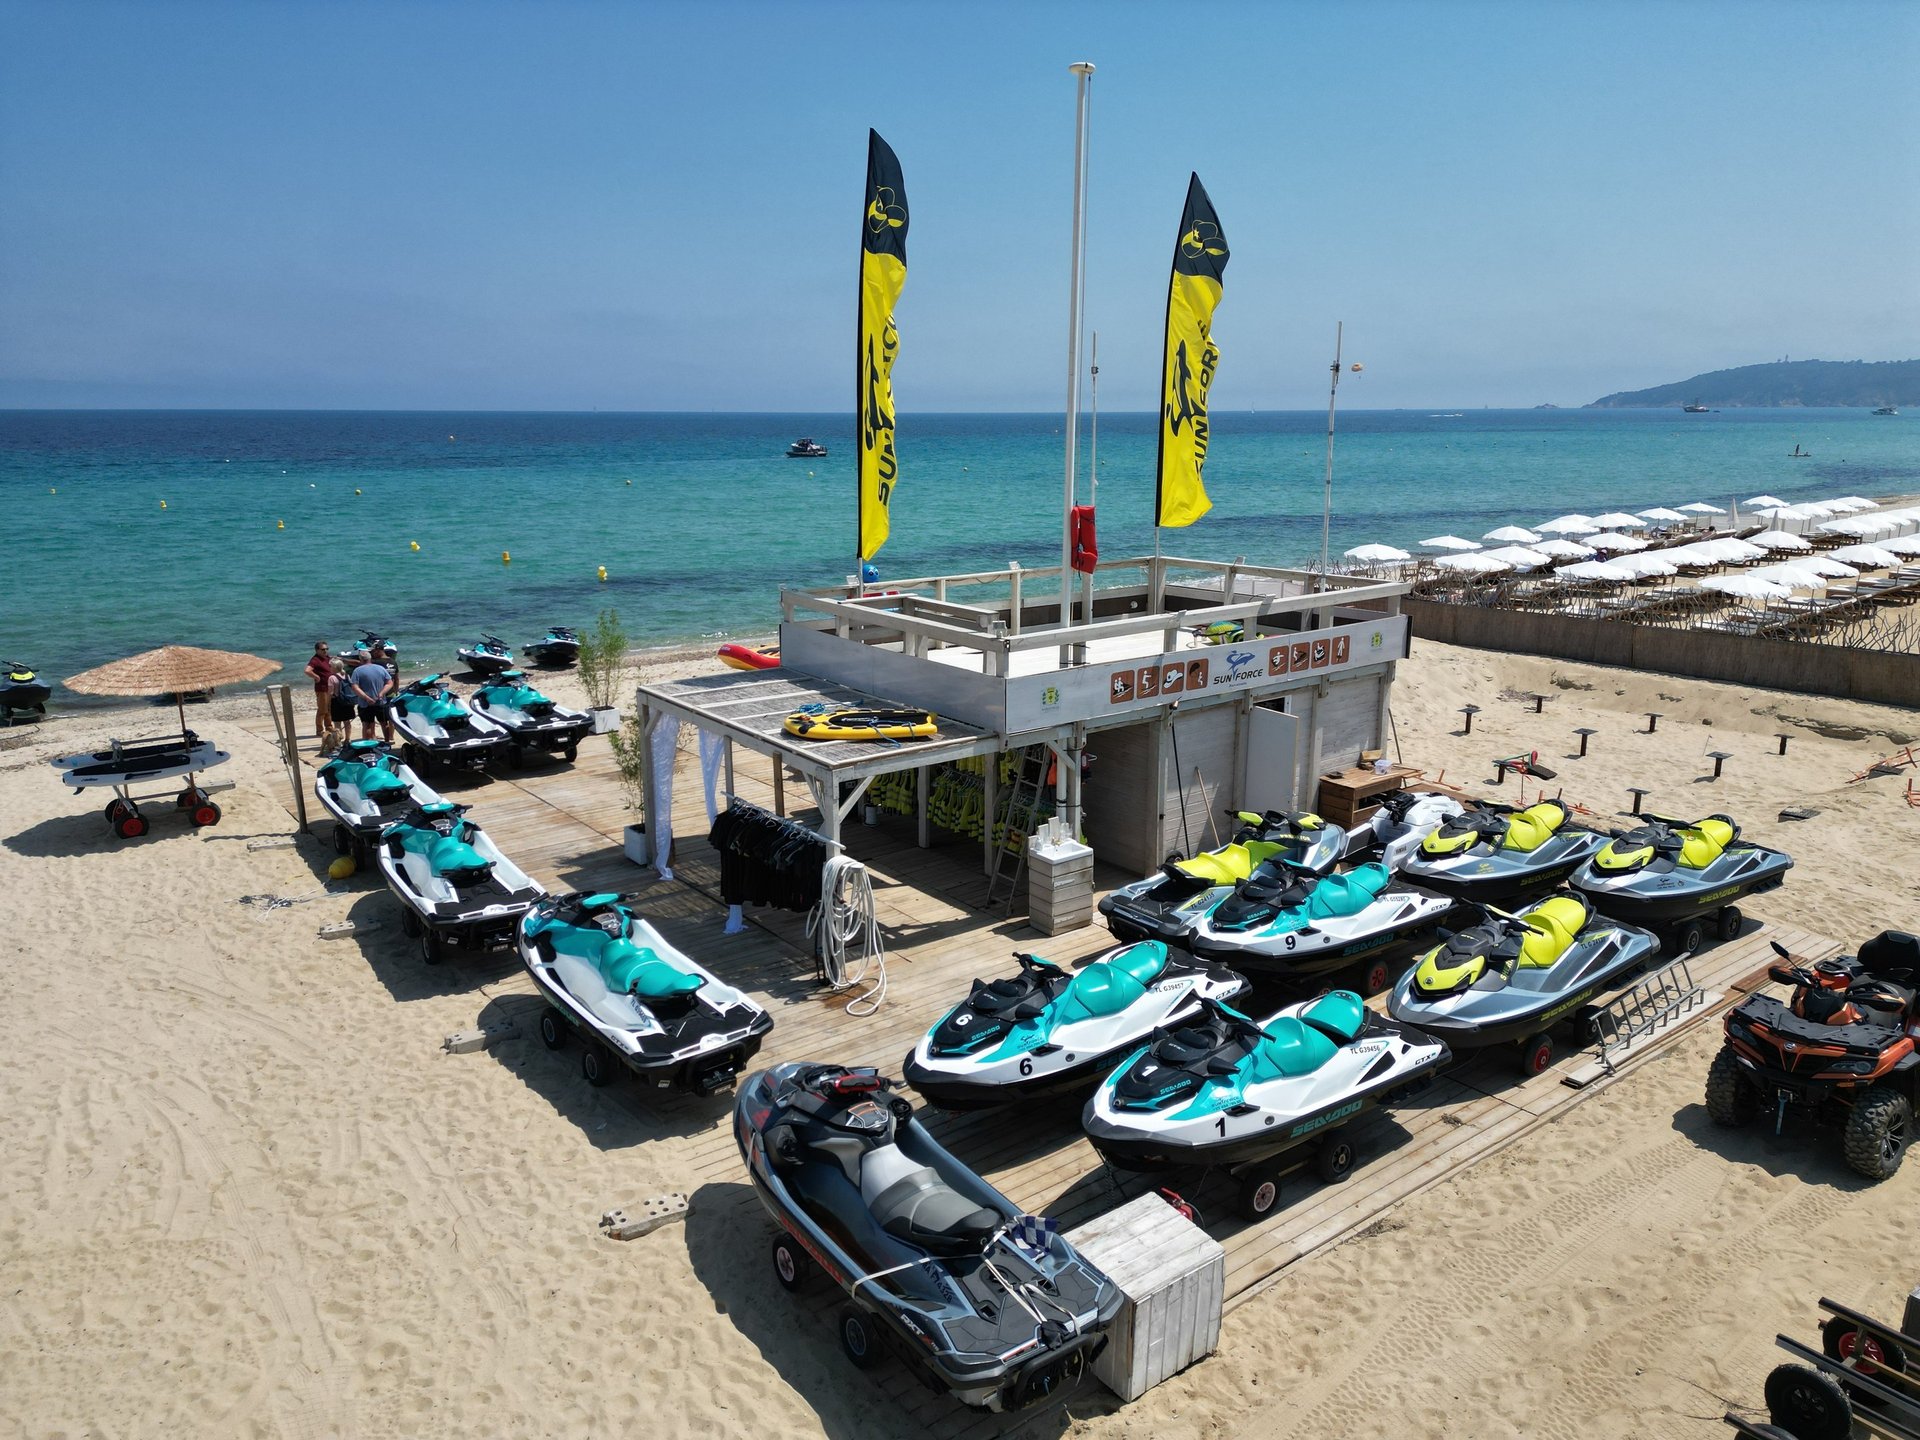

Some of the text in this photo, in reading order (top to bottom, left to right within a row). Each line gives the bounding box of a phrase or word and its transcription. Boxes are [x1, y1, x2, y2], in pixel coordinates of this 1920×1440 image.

[1213, 674, 1232, 685] SUN
[1235, 668, 1263, 681] FORCE
[1285, 934, 1297, 951] 9
[1154, 982, 1185, 994] TL G39457
[1215, 987, 1231, 1000] GTX
[955, 1013, 974, 1026] 6
[1350, 1044, 1381, 1055] TL G39456
[1019, 1057, 1033, 1076] 6
[1414, 1054, 1432, 1066] GTX
[1141, 1065, 1159, 1077] 1
[1215, 1117, 1226, 1138] 1
[900, 1313, 925, 1336] RXT
